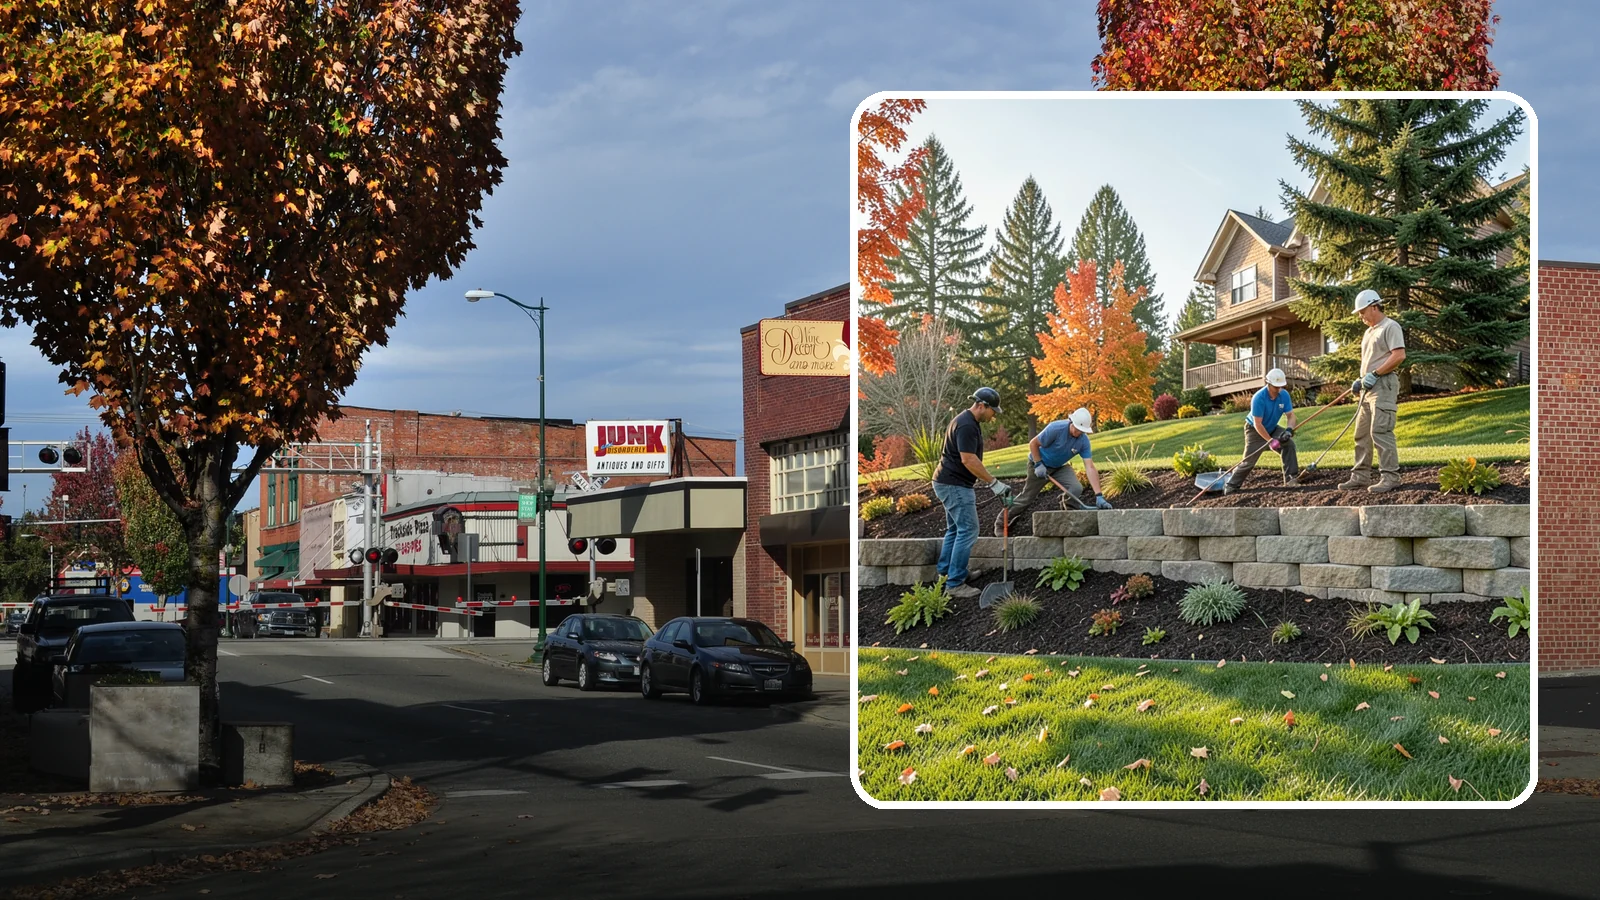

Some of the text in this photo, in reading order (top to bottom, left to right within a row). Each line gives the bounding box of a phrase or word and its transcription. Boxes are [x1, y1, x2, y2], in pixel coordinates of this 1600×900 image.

[595, 425, 665, 457] JUNK
[607, 446, 646, 454] DISORDERLY
[597, 460, 665, 470] ANTIQUES AND GIFTS
[590, 476, 608, 492] SING
[352, 498, 364, 511] CRO
[415, 519, 429, 535] Pizza
